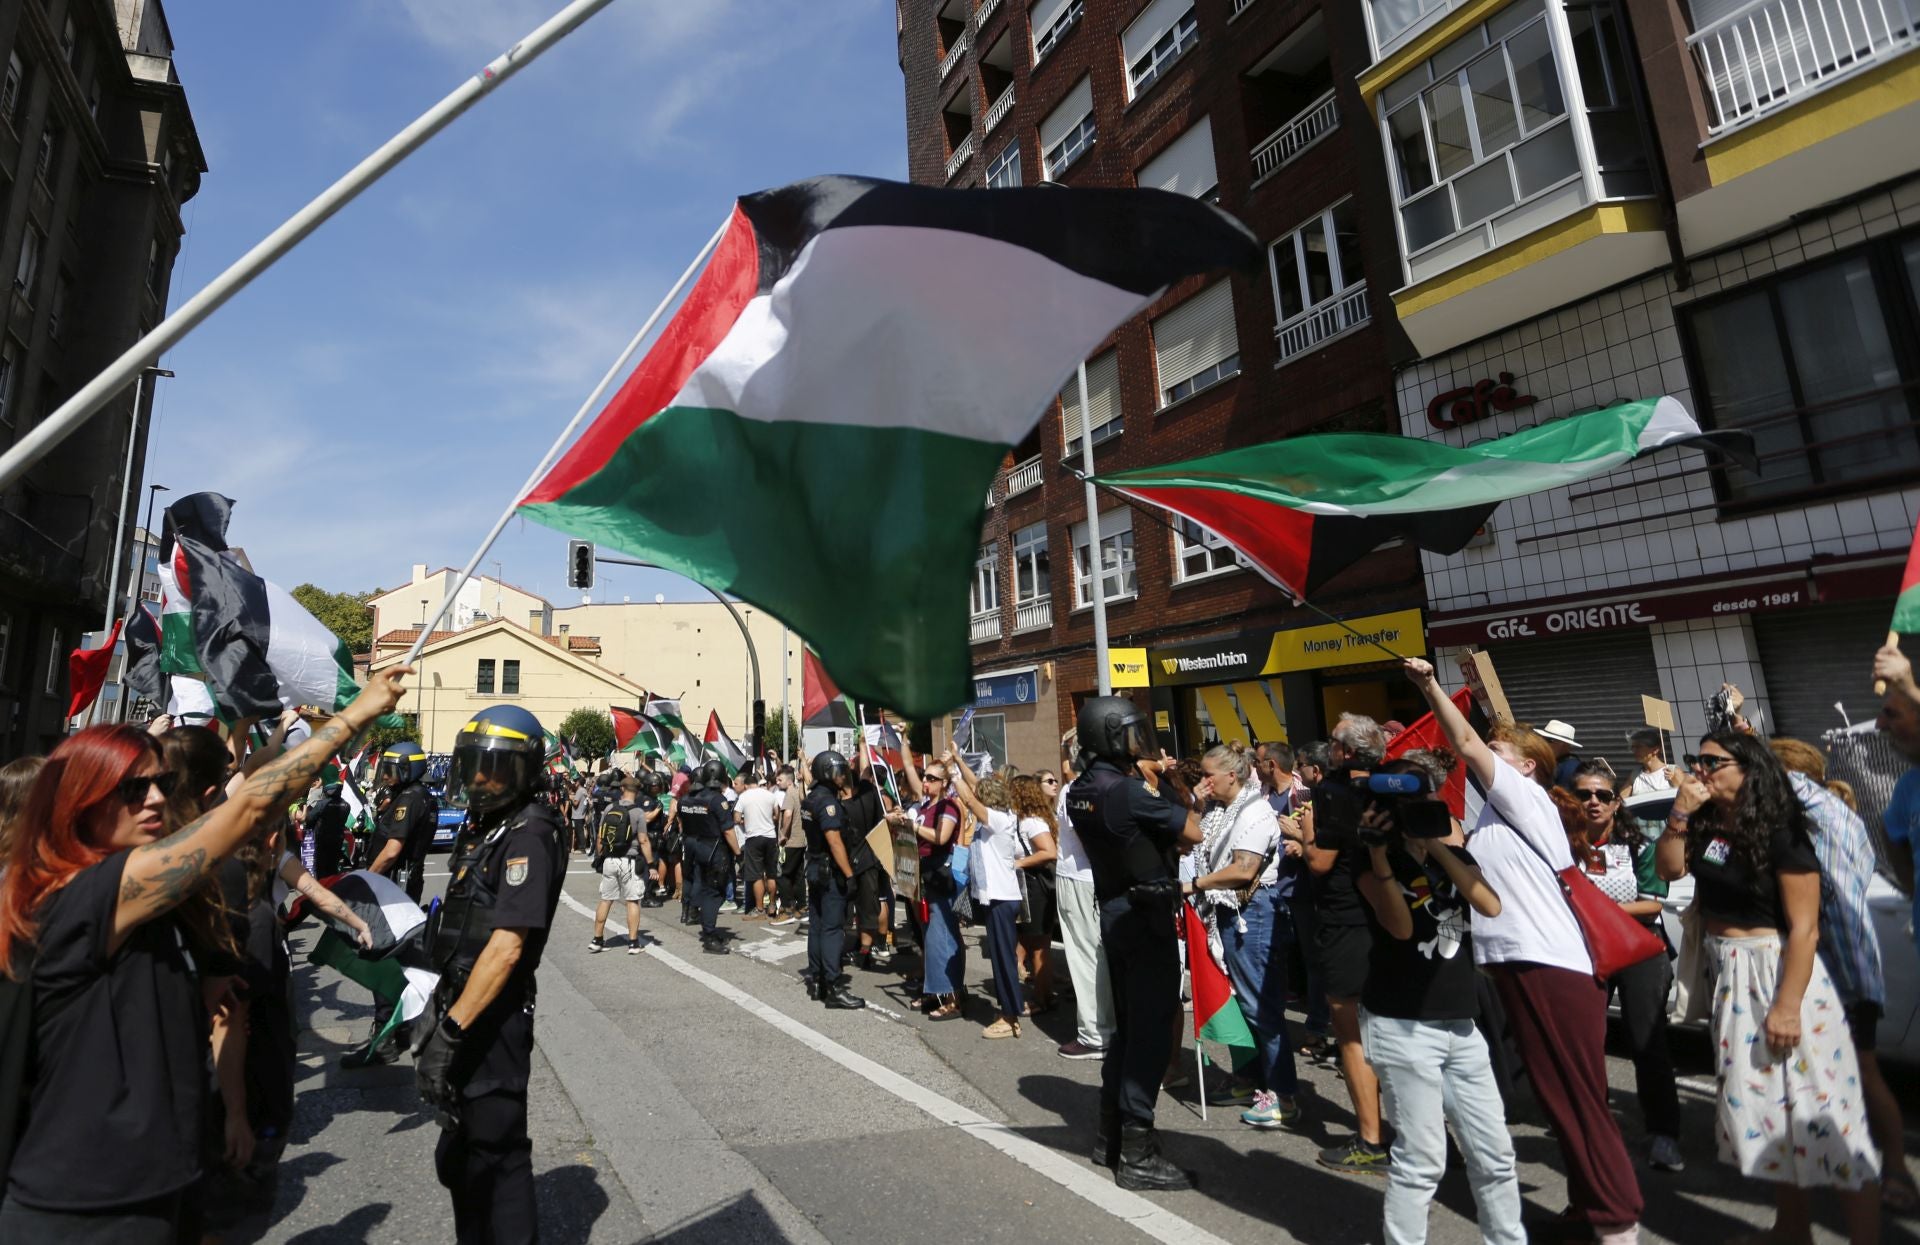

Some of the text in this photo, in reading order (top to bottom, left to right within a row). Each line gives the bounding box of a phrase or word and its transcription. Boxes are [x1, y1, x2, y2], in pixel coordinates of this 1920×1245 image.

[1427, 371, 1538, 430] Café
[1713, 591, 1800, 613] desde 1981
[1546, 602, 1656, 632] ORIENTE
[1303, 629, 1400, 654] Money Transfer
[1179, 655, 1217, 672] Western
[1216, 651, 1247, 667] Union
[975, 681, 993, 698] Villa
